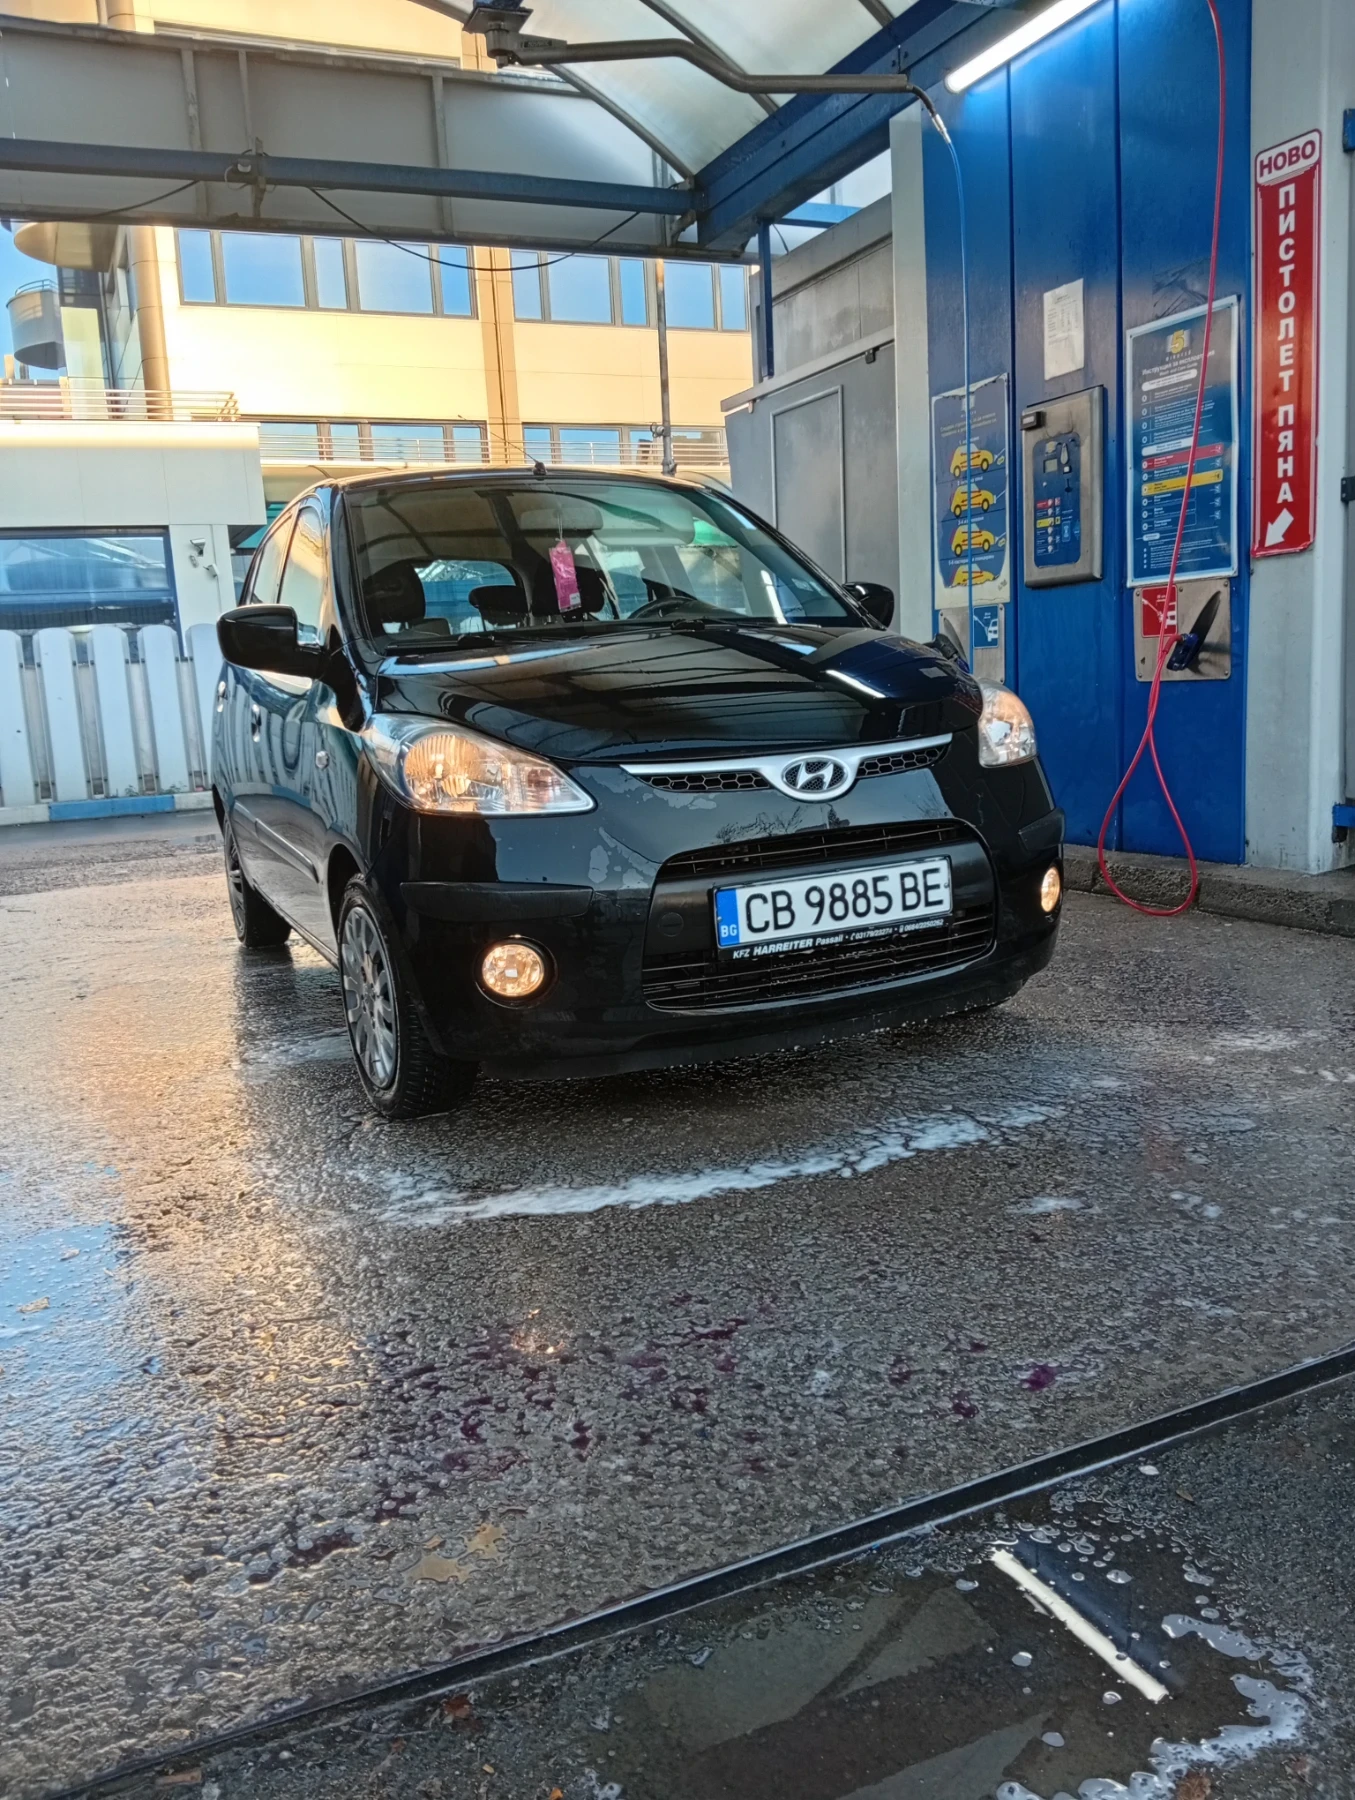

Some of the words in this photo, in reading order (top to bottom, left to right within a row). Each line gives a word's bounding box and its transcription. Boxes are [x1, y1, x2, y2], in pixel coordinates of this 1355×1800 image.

[1259, 139, 1316, 178] НОВО
[1278, 183, 1296, 392] ПИСТОЛЕТ
[1277, 404, 1294, 504] ПЯНА
[745, 889, 796, 934] CB
[804, 875, 893, 926] 9885
[900, 867, 944, 912] BE
[721, 924, 738, 938] BG
[733, 948, 751, 959] KFZ
[753, 938, 814, 956] HARREITER
